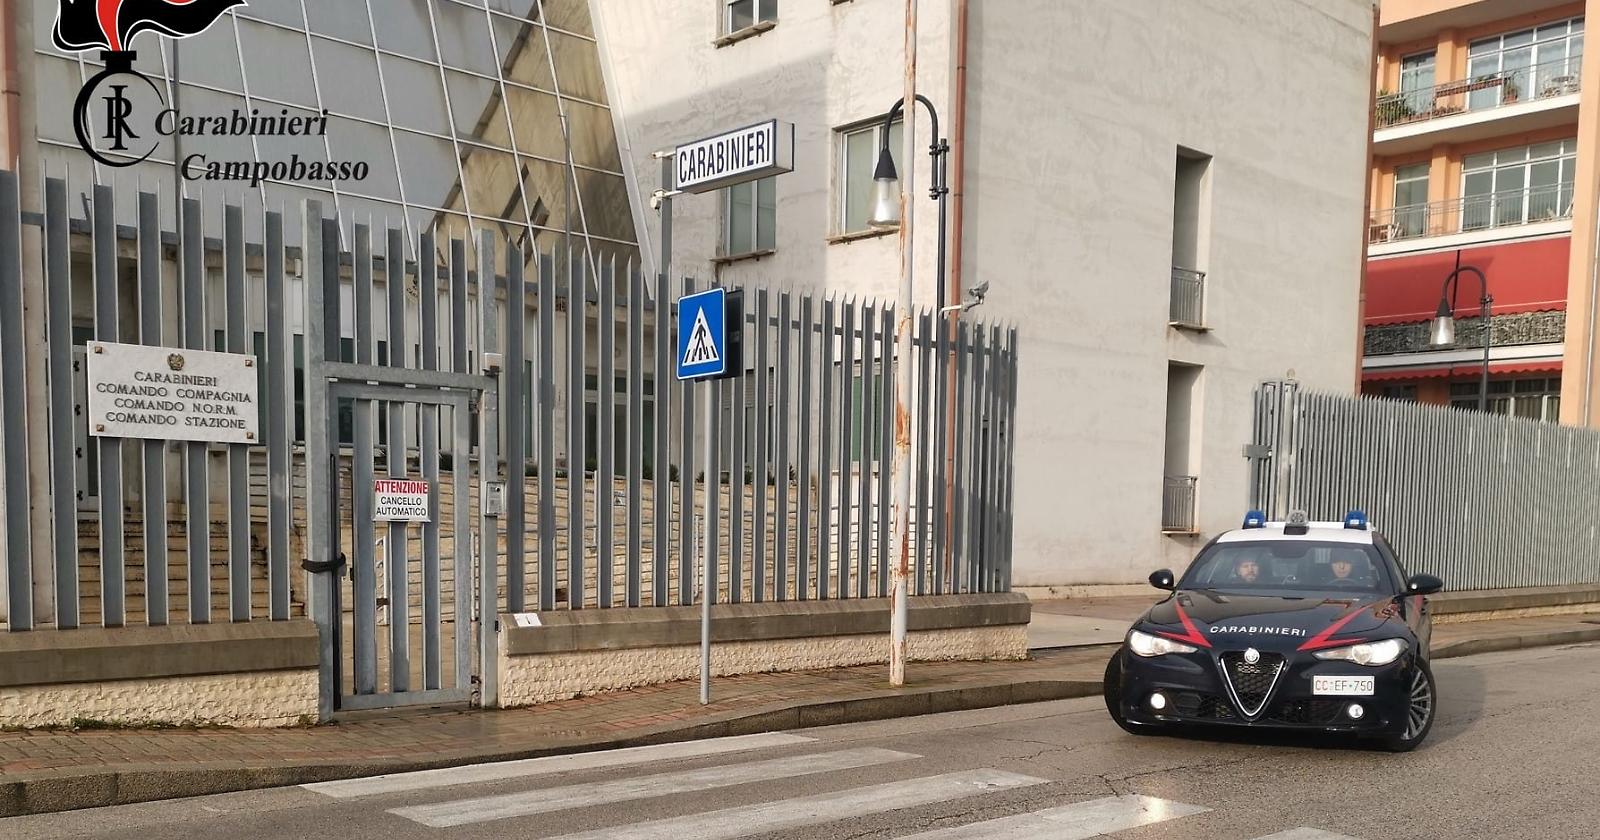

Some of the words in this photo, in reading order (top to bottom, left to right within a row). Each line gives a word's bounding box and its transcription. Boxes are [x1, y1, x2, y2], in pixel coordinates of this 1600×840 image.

[679, 127, 770, 183] CARABINIERI
[134, 371, 217, 387] CARABINIERI
[96, 383, 168, 397] COMANDO
[176, 389, 252, 403] COMPAGNIA
[114, 398, 185, 412] COMANDO
[105, 412, 177, 426] COMANDO
[185, 416, 246, 430] STAZIONE
[375, 480, 428, 494] ATTENZIONE
[380, 496, 422, 506] CANCELLO
[376, 507, 427, 516] AUTOMATICO
[1209, 625, 1306, 637] CARABINIERI
